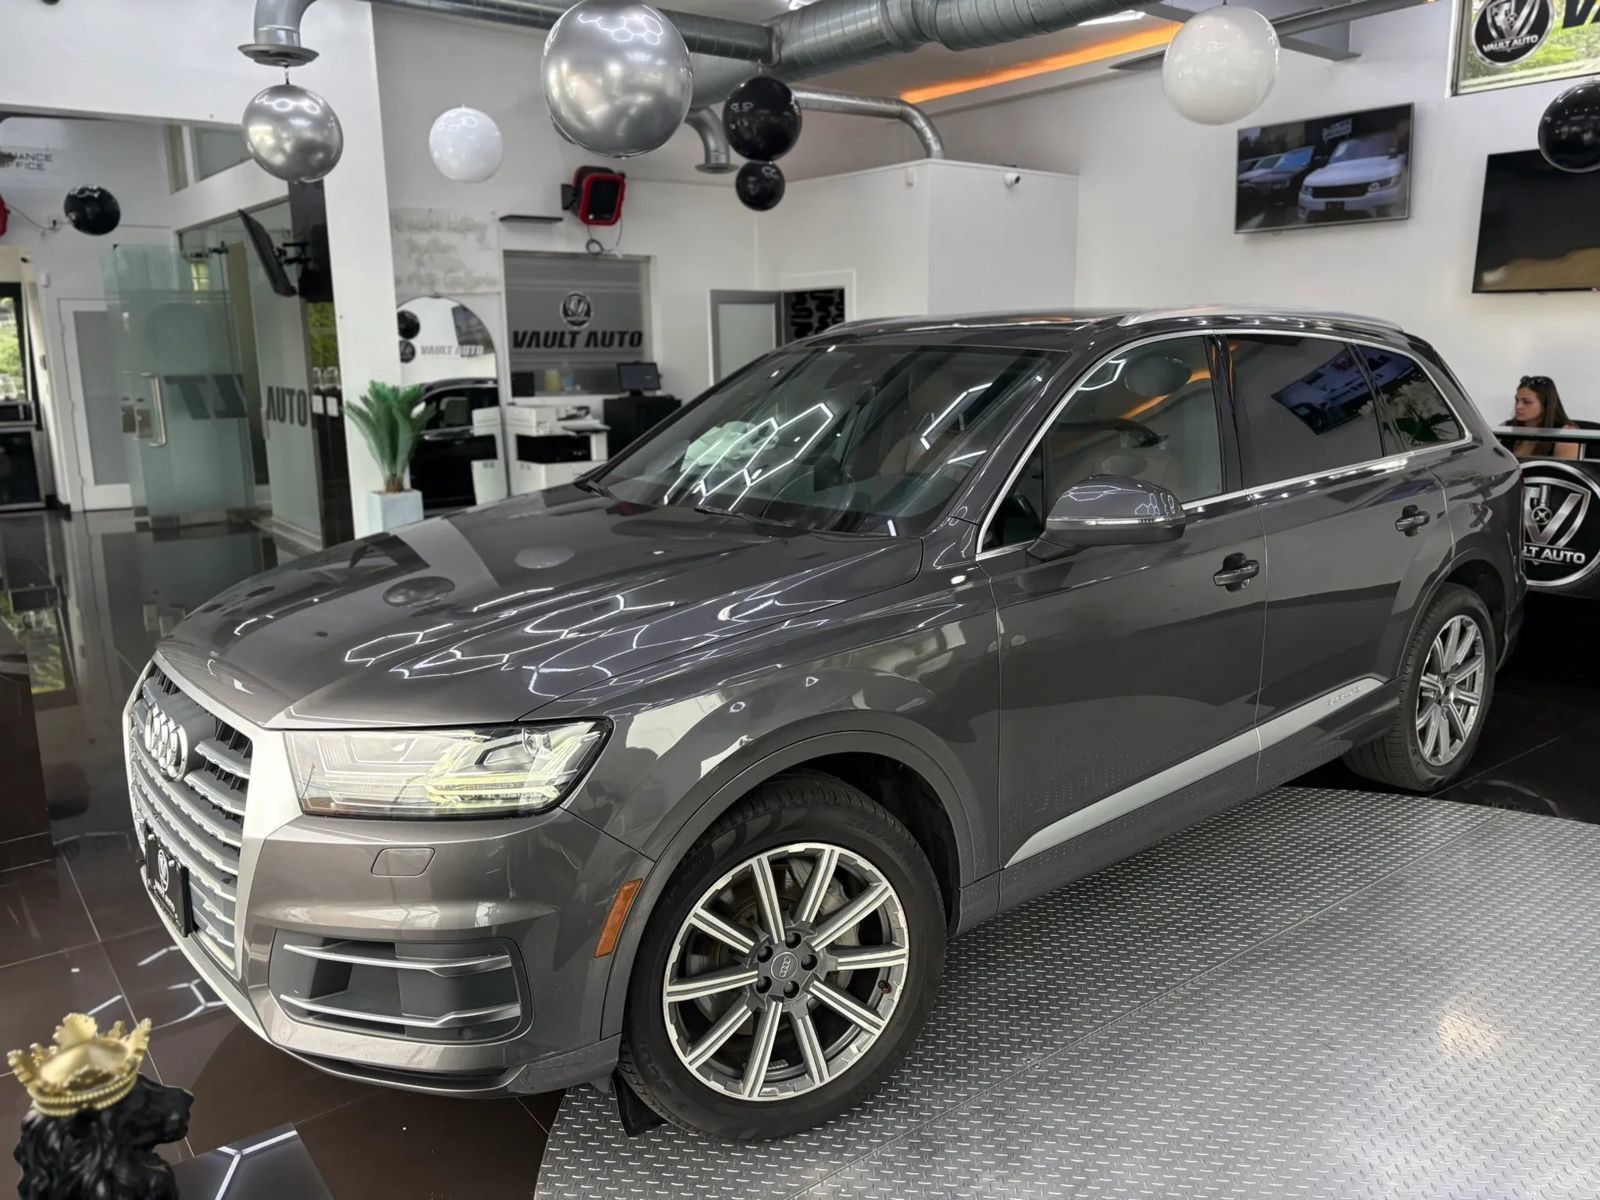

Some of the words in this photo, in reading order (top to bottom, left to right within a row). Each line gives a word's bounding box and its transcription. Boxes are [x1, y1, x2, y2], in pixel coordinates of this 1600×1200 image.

[1482, 39, 1510, 52] VAULT
[1511, 34, 1539, 48] AUTO
[513, 330, 581, 349] VAULT
[584, 330, 643, 348] AUTO
[266, 386, 308, 427] AUTO
[1521, 545, 1540, 558] LT
[1541, 548, 1586, 565] AUTO
